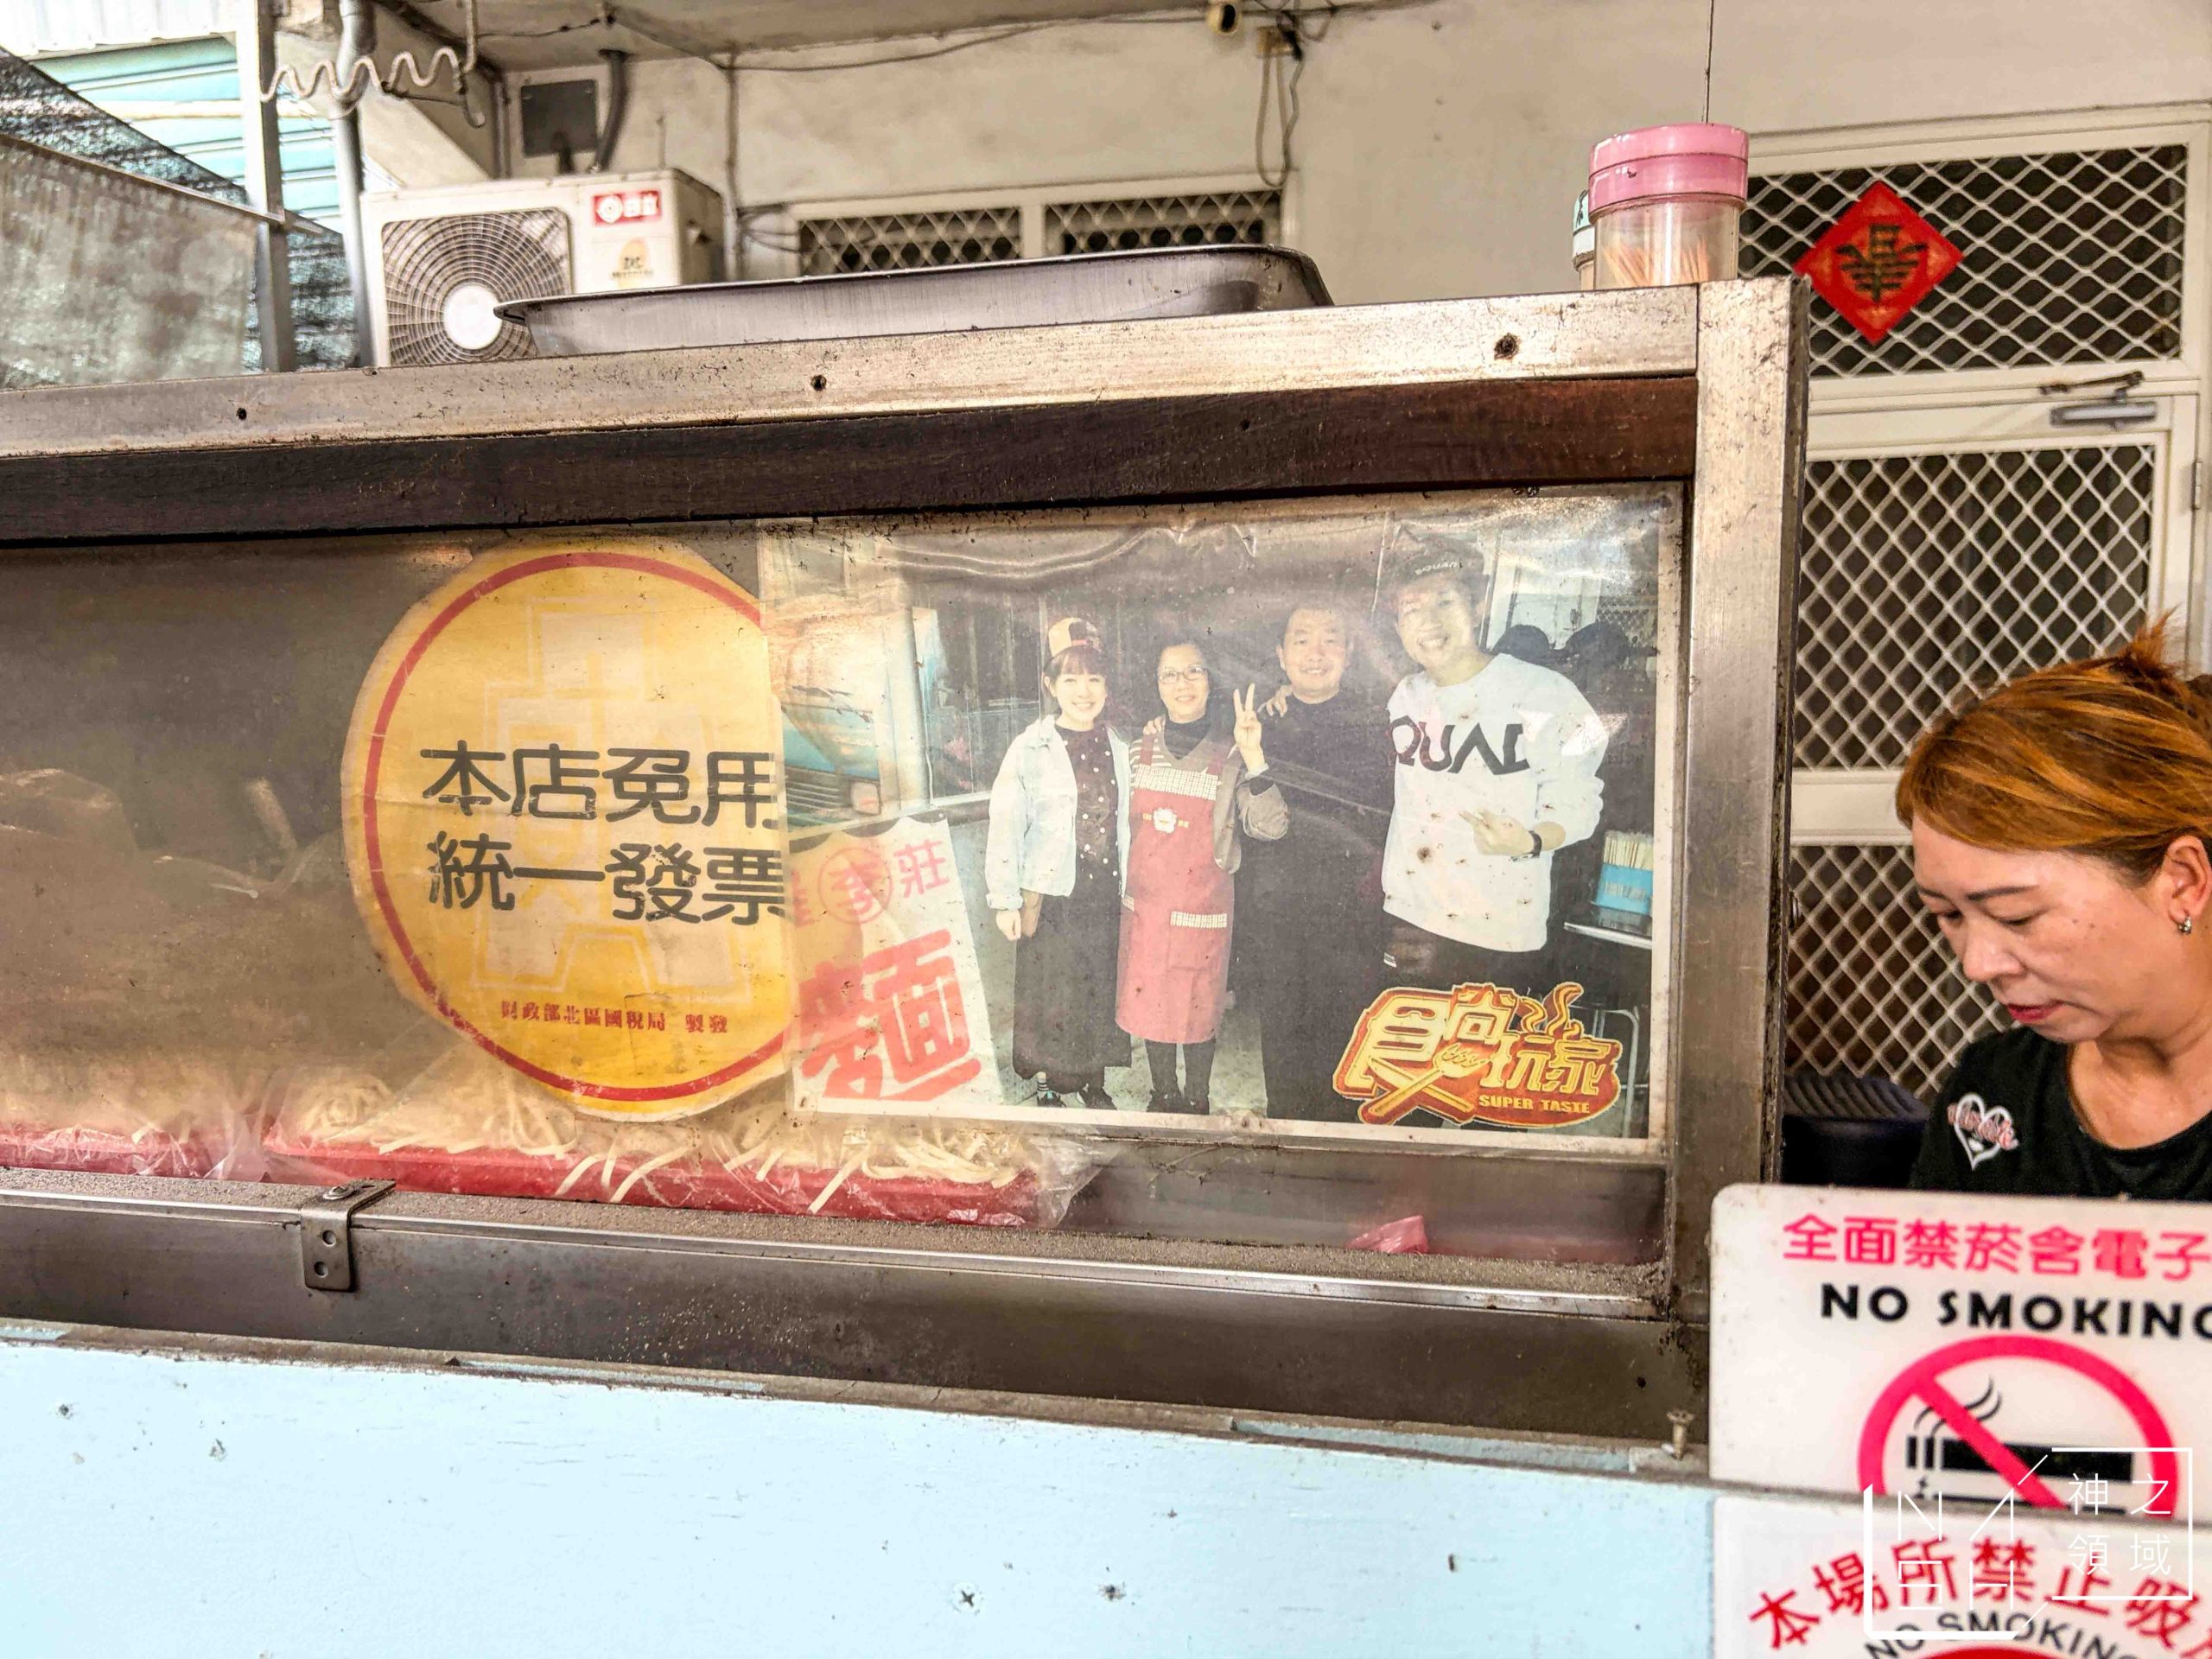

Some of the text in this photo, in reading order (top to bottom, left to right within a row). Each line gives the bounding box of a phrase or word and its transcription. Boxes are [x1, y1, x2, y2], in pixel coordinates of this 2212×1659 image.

[420, 740, 779, 830] 本店免用
[427, 830, 787, 925] 統一發票
[1478, 1094, 1591, 1114] SUPER TASTE
[1783, 1212, 2211, 1282] 全面禁菸含電子
[1821, 1282, 1909, 1322] NO
[1749, 1535, 2212, 1659] 本場所禁止吸
[1936, 1611, 2139, 1659] SMOKIN
